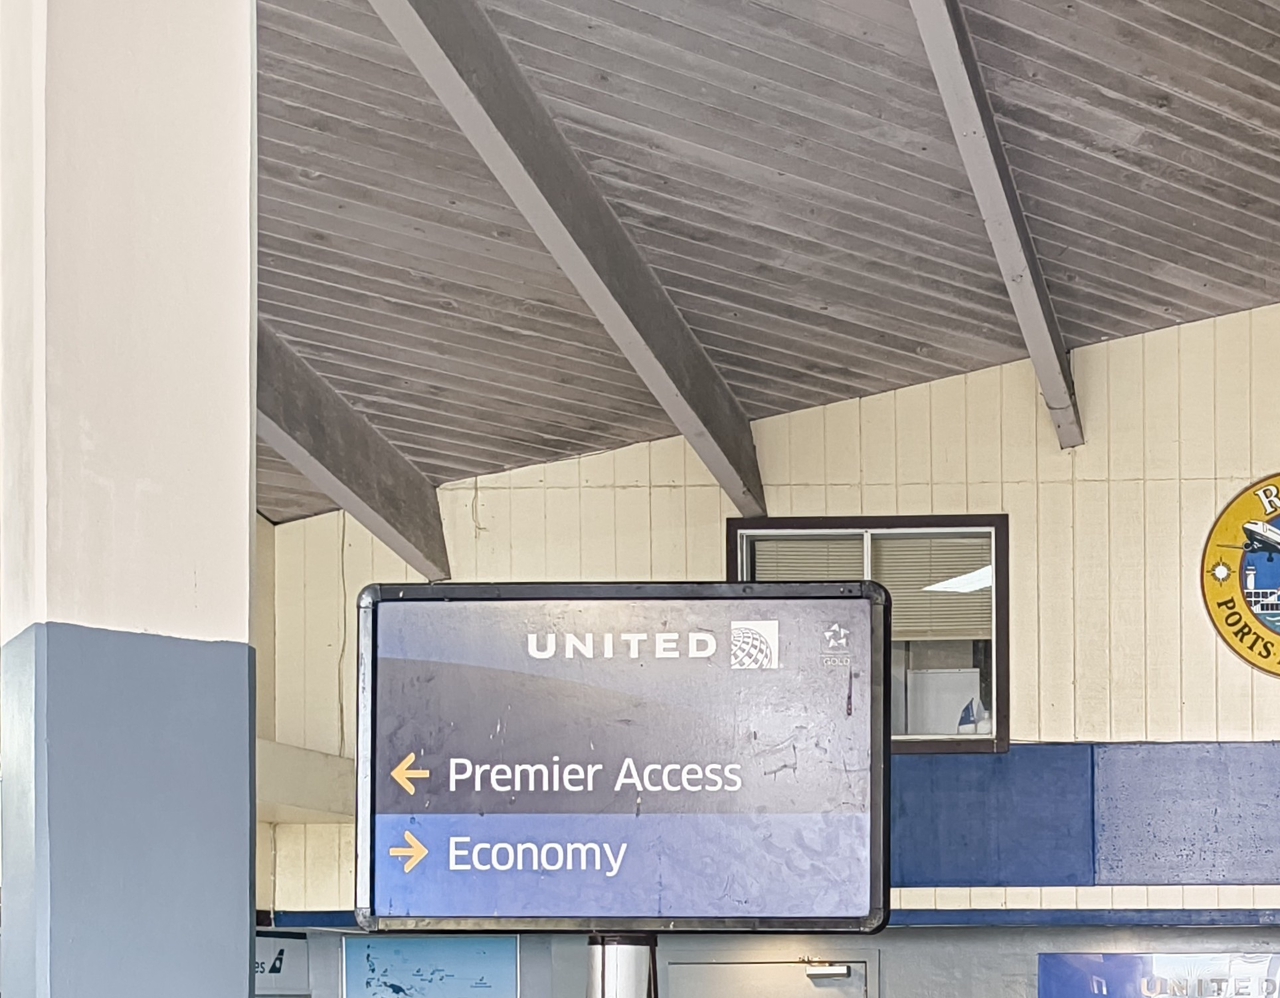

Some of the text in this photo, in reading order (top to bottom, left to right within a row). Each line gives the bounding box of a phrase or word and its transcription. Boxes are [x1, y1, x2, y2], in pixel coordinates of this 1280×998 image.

[526, 632, 717, 659] UNITED
[1216, 596, 1276, 660] PORTS
[449, 756, 742, 791] Premier Access
[448, 835, 627, 877] Economy
[1140, 976, 1277, 997] UNITED
